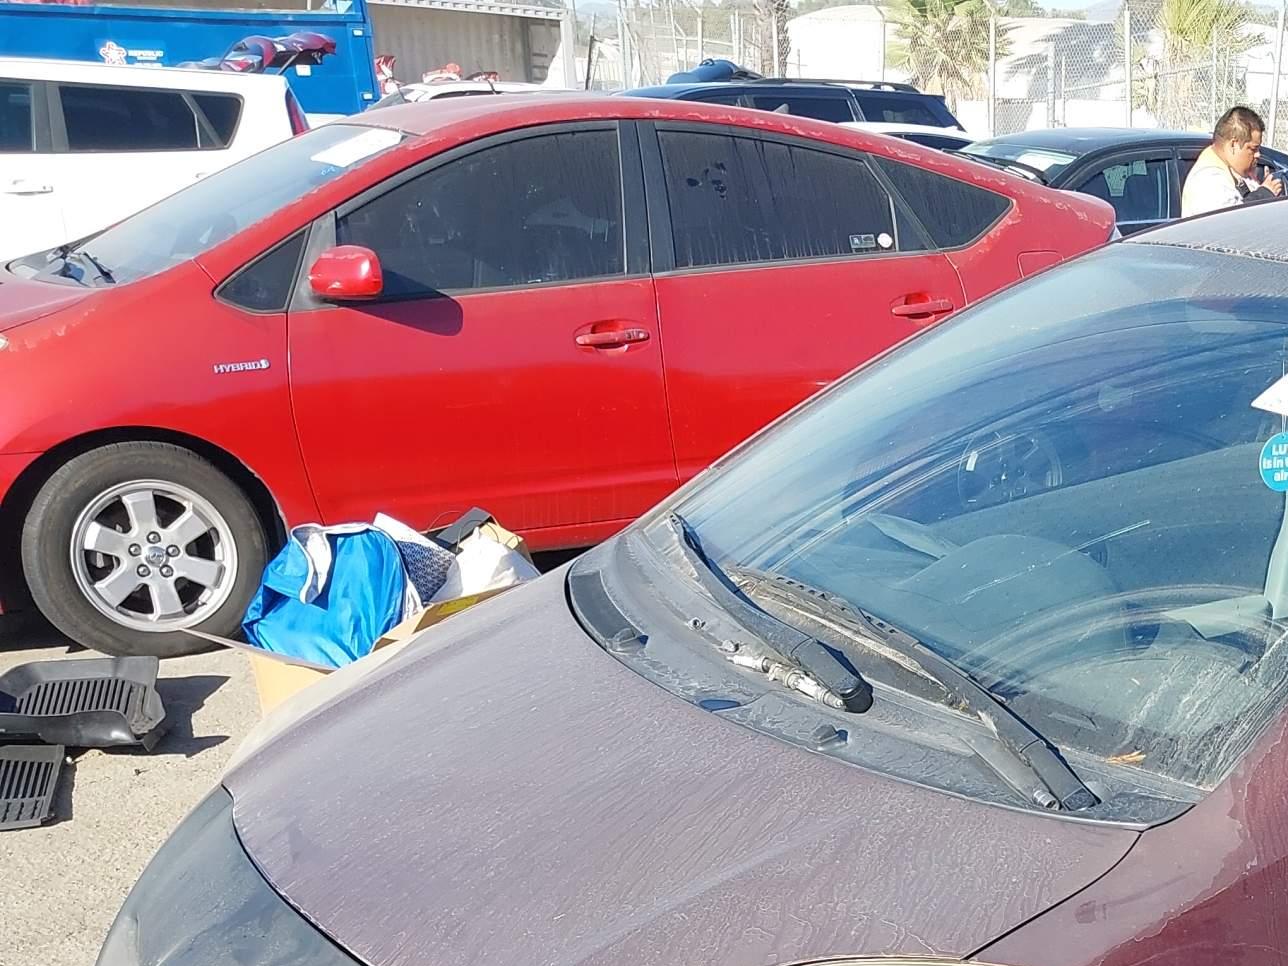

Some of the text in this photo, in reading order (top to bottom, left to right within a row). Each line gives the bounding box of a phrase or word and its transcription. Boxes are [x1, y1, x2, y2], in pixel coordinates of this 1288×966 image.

[213, 361, 261, 374] HYBRID
[1263, 456, 1273, 470] is
[1273, 456, 1284, 469] in
